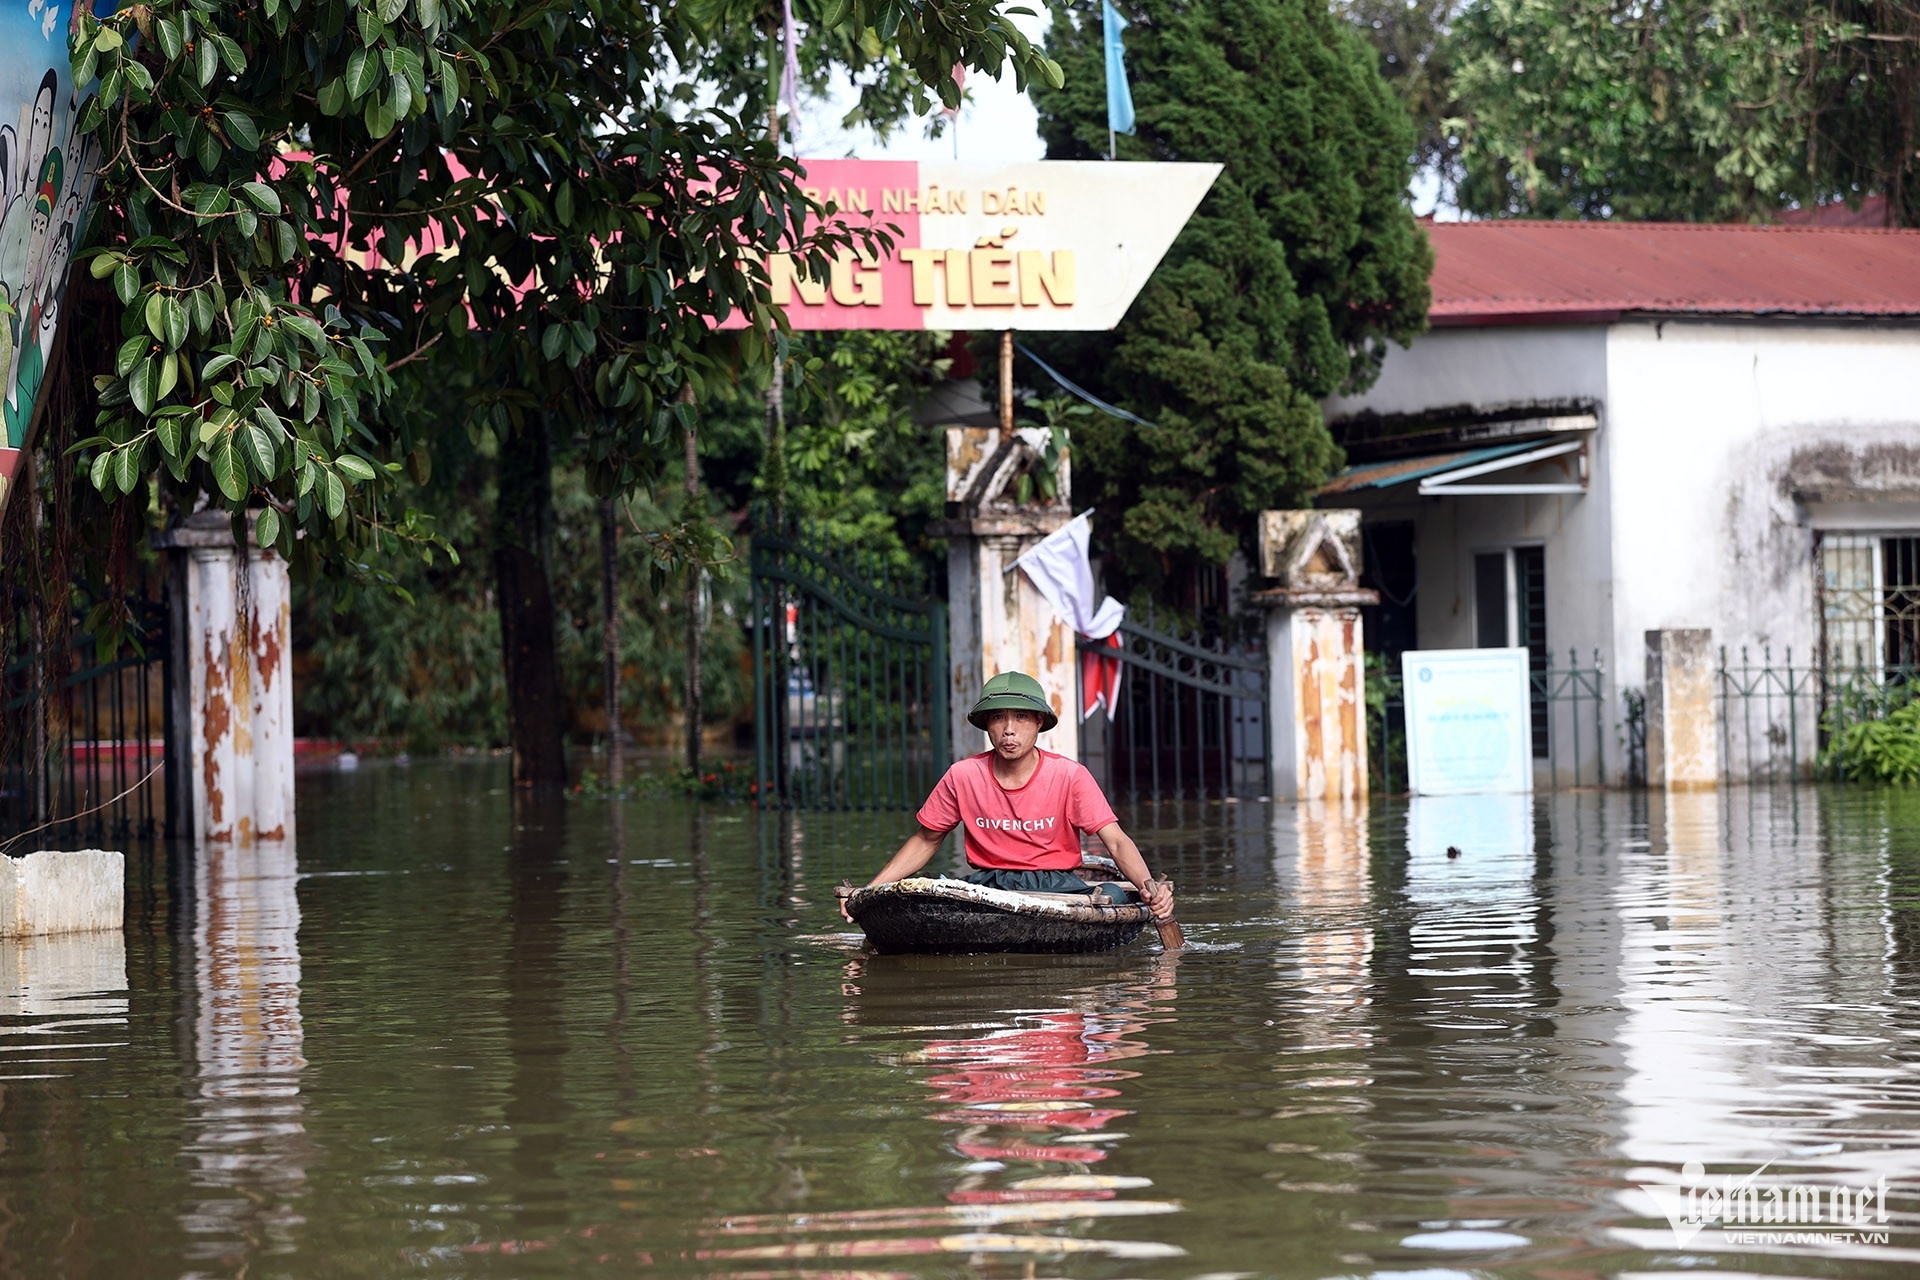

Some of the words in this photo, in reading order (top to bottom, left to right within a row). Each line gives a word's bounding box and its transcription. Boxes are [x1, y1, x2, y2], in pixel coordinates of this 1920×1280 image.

[802, 187, 866, 214] BAN
[880, 185, 968, 215] NHÂN
[982, 187, 1046, 216] DÂN
[900, 226, 1074, 307] TIẾN
[975, 816, 1055, 832] GIVENCHY
